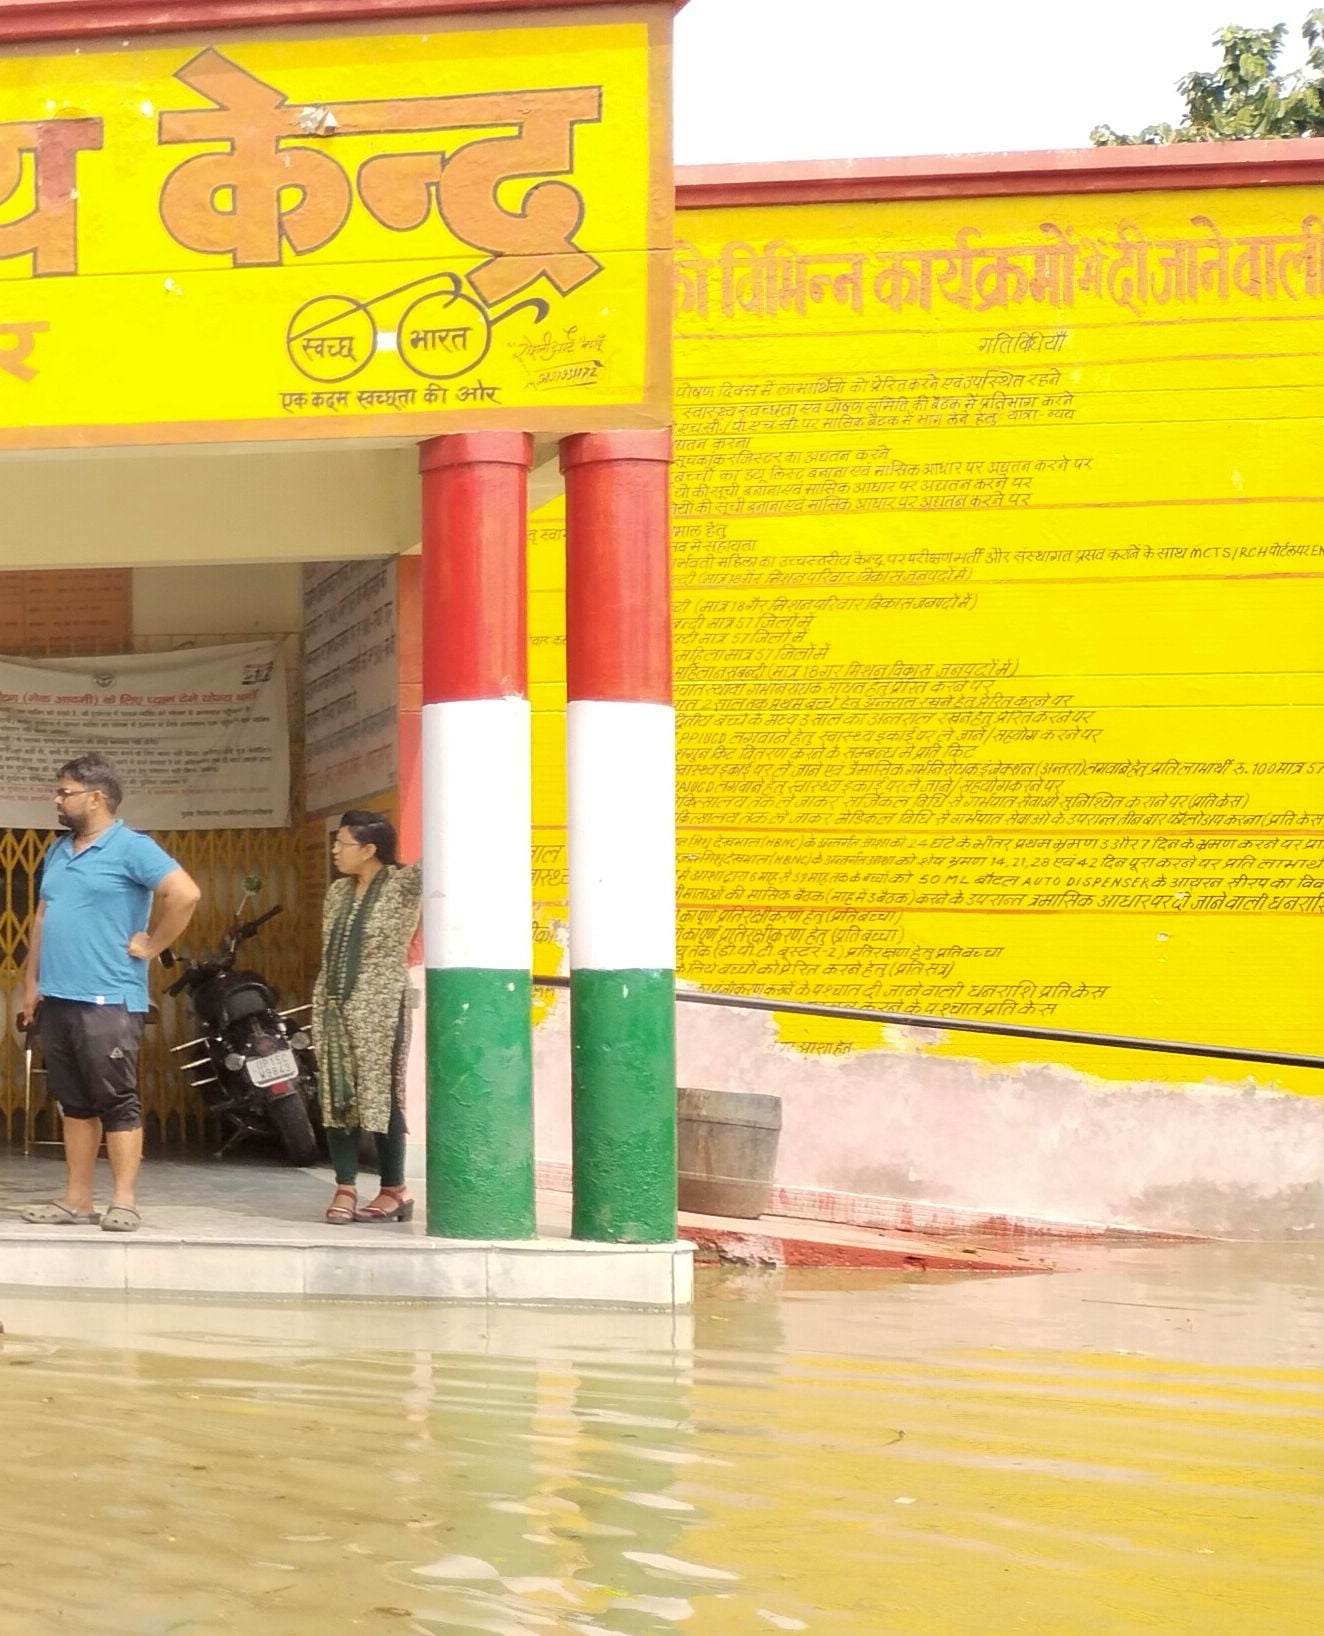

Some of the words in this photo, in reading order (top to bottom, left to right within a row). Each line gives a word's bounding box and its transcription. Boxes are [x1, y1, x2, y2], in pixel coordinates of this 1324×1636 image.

[157, 46, 605, 308] केन्द्र
[873, 222, 1079, 312] कार्यक्रमों
[1152, 215, 1232, 304] जाने
[301, 335, 357, 362] स्वच्छ
[409, 326, 474, 352] भारत
[280, 391, 308, 414] एक
[311, 390, 349, 412] कदम
[424, 384, 450, 403] की
[1157, 546, 1187, 560] साथ
